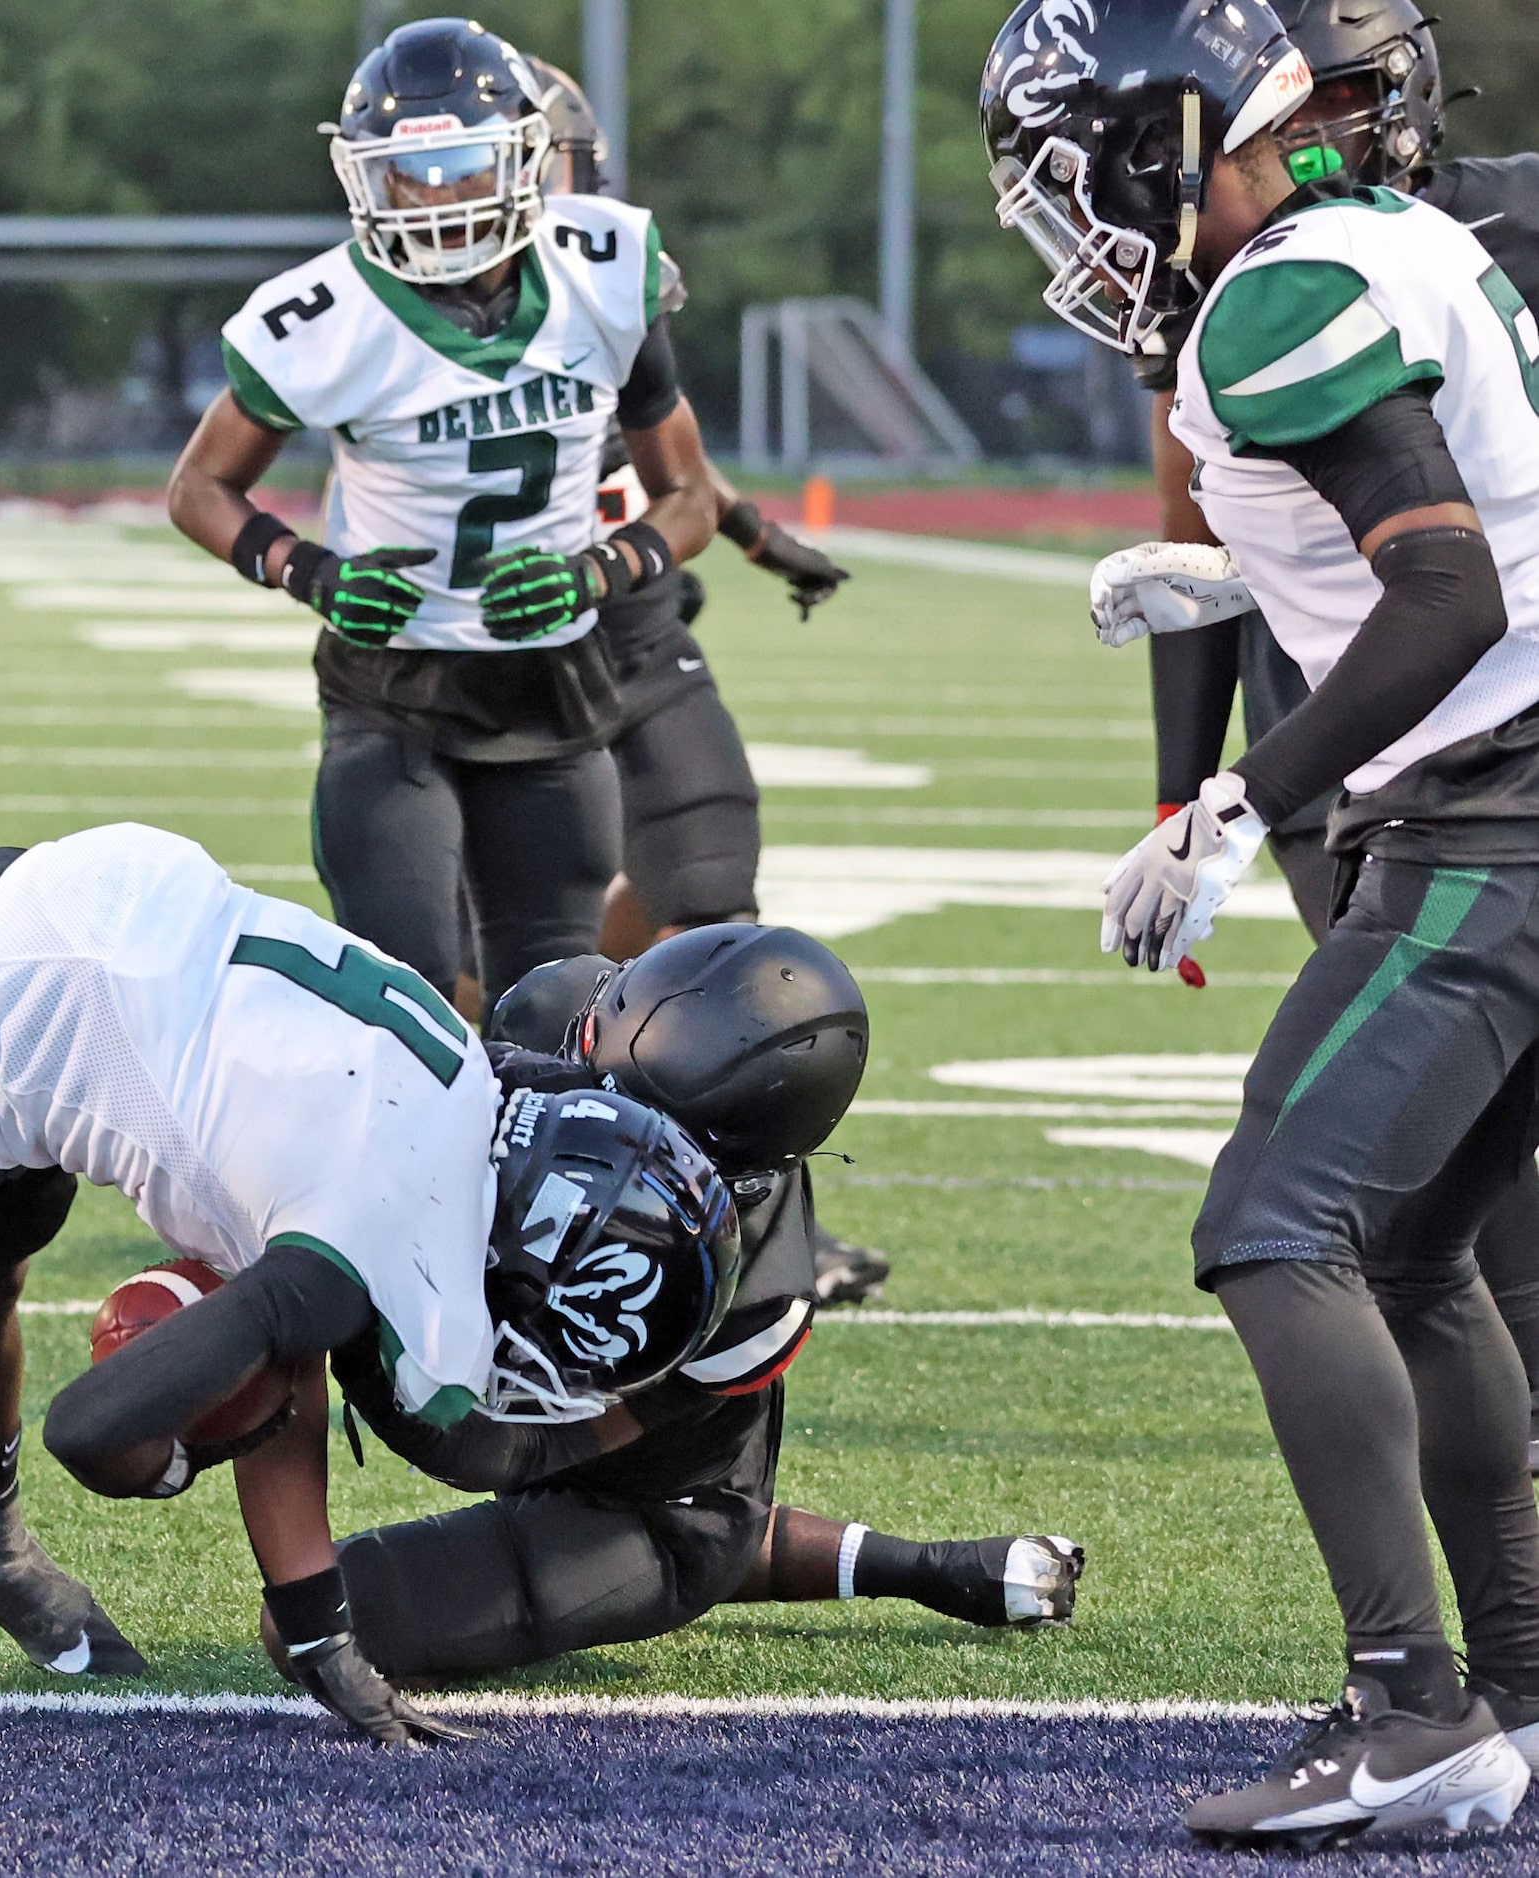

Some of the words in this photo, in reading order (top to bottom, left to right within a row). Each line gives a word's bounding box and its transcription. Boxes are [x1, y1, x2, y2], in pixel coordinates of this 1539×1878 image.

[555, 225, 617, 263] 2
[261, 281, 336, 340] 2
[448, 430, 559, 590] 2
[228, 934, 469, 1091] 4
[509, 1091, 548, 1148] schutt
[559, 1098, 620, 1123] 4
